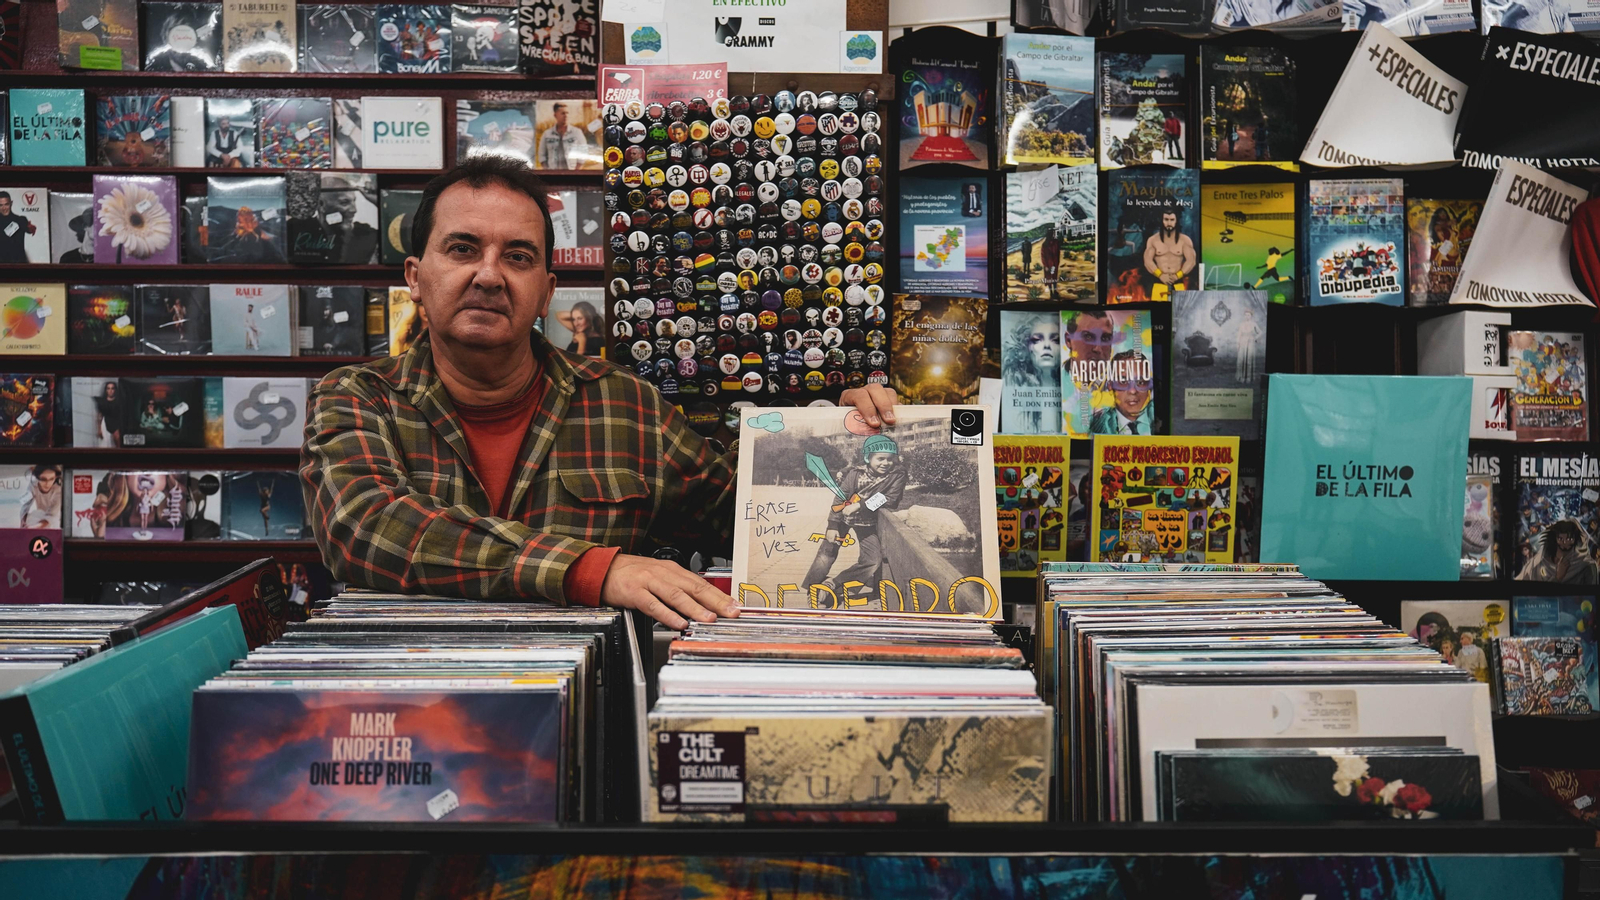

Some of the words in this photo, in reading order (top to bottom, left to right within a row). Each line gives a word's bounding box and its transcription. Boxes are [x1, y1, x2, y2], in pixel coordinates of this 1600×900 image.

[238, 3, 280, 11] TABURETE
[521, 26, 595, 54] STEEN
[725, 36, 776, 48] GRAMMY
[521, 44, 574, 64] WRECKING
[574, 53, 597, 68] BALL
[1052, 45, 1064, 53] por
[1016, 52, 1041, 62] Campo
[1054, 54, 1084, 62] Gibraltar
[1224, 54, 1247, 62] Andar
[398, 62, 424, 74] Boney
[692, 70, 713, 81] 1,20
[714, 69, 723, 79] €
[1102, 58, 1110, 112] Excursionista
[1132, 80, 1156, 88] Andar
[606, 88, 641, 97] PERRO
[706, 89, 714, 99] 3
[716, 88, 725, 98] €
[1127, 88, 1146, 97] Campo
[1154, 89, 1180, 97] Gibraltar
[13, 116, 28, 128] EL
[31, 113, 82, 128] ÚLTIMO
[14, 130, 30, 141] DE
[33, 130, 52, 141] LA
[54, 129, 82, 142] FILA
[373, 120, 430, 144] pure
[1103, 127, 1111, 147] Guía
[670, 150, 682, 158] BIG
[1546, 158, 1600, 168] HOTTA
[1213, 190, 1238, 200] Entre
[1238, 190, 1258, 200] Tres
[1260, 190, 1284, 199] Palos
[1505, 174, 1578, 226] ESPECIALES
[1136, 199, 1162, 208] leyenda
[552, 248, 604, 264] IBERT
[235, 287, 264, 296] RAULE
[1320, 275, 1396, 296] Dibupedia
[1465, 279, 1533, 305] TOMOYUKI
[1536, 290, 1582, 305] HOTTA
[904, 320, 914, 330] El
[916, 320, 950, 332] enigma
[952, 322, 962, 330] de
[964, 322, 978, 332] las
[912, 333, 936, 342] niñas
[938, 334, 968, 343] dobles
[1070, 358, 1151, 382] ARGOMENTO
[1012, 389, 1033, 398] Juan
[1036, 388, 1062, 398] Emilio
[1572, 391, 1582, 406] B
[1024, 446, 1065, 464] ESPAÑOL
[1103, 446, 1130, 464] ROCK
[1132, 445, 1190, 464] PROGRESIVO
[1192, 446, 1234, 464] ESPAÑOL
[1316, 464, 1336, 480] EL
[1342, 460, 1414, 480] ÚLTIMO
[1520, 457, 1539, 476] EL
[1536, 478, 1581, 486] Historietas
[1315, 482, 1338, 497] DE
[1344, 482, 1368, 498] LA
[1374, 482, 1412, 498] FILA
[744, 500, 800, 522] ÉRASE
[1148, 512, 1160, 521] los
[1160, 512, 1184, 522] discos
[755, 523, 786, 538] UNA
[1156, 522, 1166, 532] de
[1158, 534, 1182, 548] 70
[350, 712, 397, 737] MARK
[678, 733, 715, 748] THE
[332, 737, 412, 762] KNOPFLER
[678, 748, 725, 763] CULT
[310, 762, 341, 786] ONE
[344, 762, 383, 786] DEEP
[386, 762, 433, 786] RIVER
[679, 765, 740, 780] DREAMTIME
